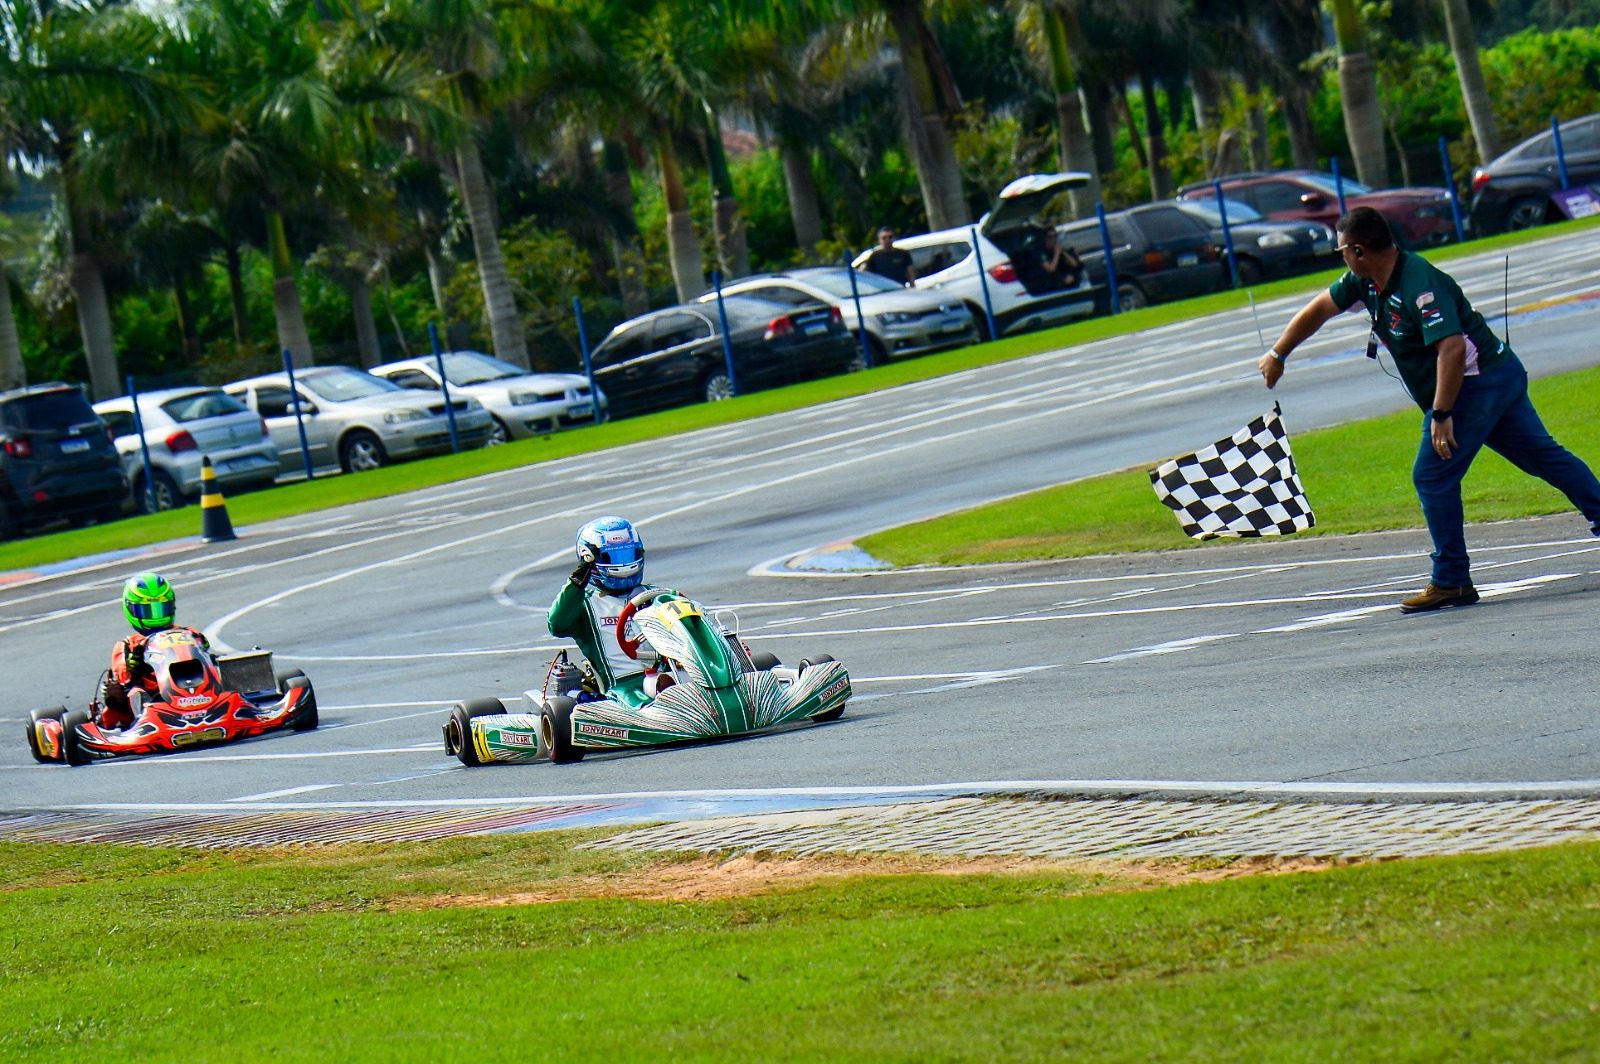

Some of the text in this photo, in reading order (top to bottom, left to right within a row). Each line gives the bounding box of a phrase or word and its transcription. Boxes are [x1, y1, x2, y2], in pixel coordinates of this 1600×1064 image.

[666, 601, 697, 615] 17
[602, 617, 620, 626] TON
[580, 725, 628, 738] TONY KART
